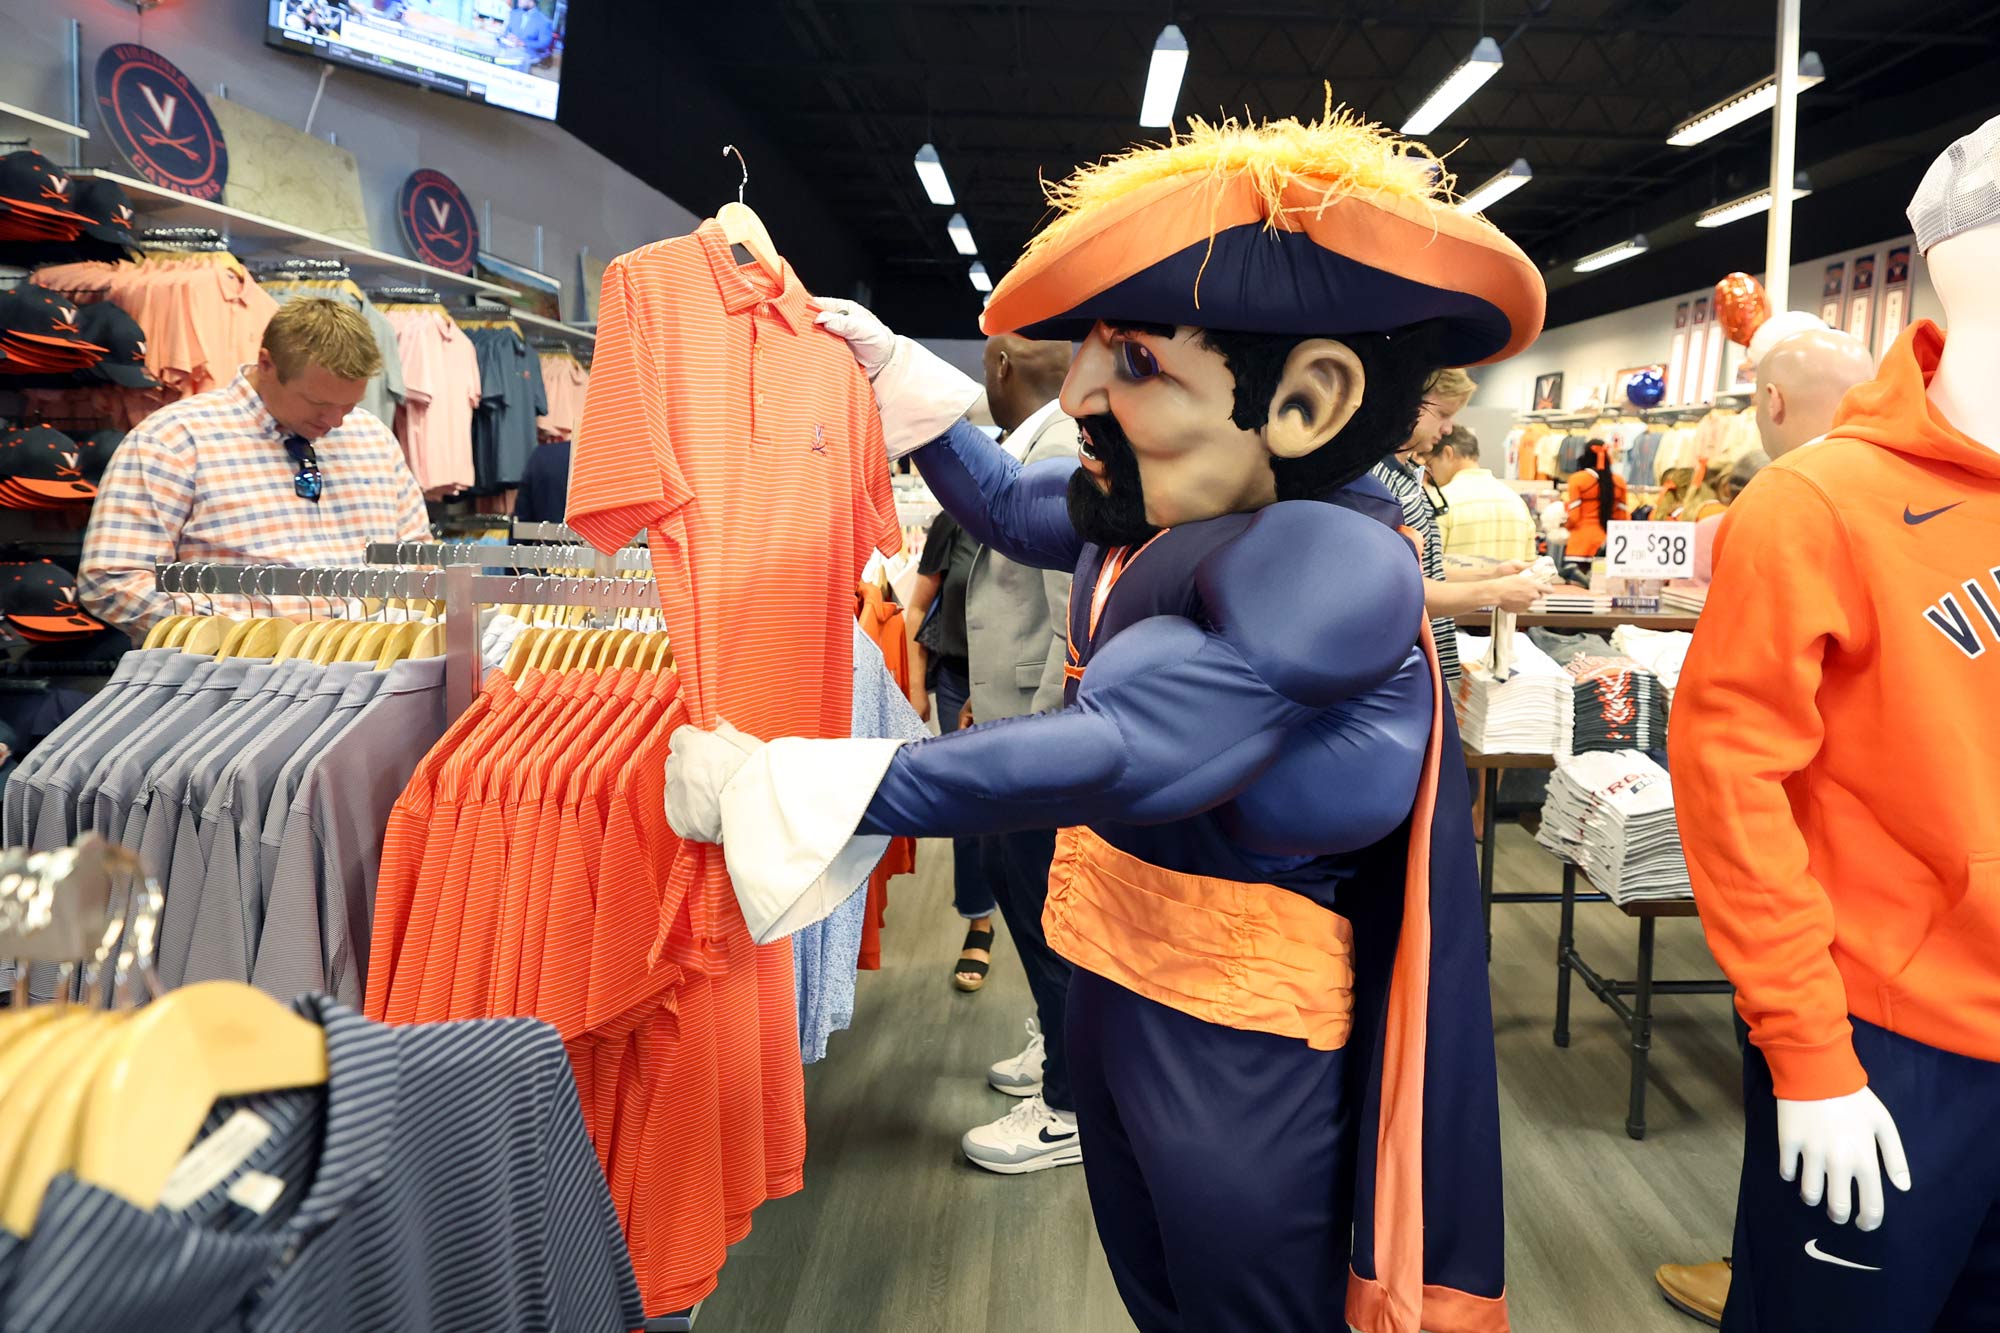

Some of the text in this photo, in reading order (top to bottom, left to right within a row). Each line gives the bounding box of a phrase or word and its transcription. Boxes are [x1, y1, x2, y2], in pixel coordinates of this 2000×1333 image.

[113, 46, 189, 89] VIRGINIA
[137, 81, 178, 134] V
[425, 195, 450, 231] V
[1614, 535, 1628, 565] 2
[1647, 533, 1687, 566] $38
[1921, 564, 2000, 660] VI
